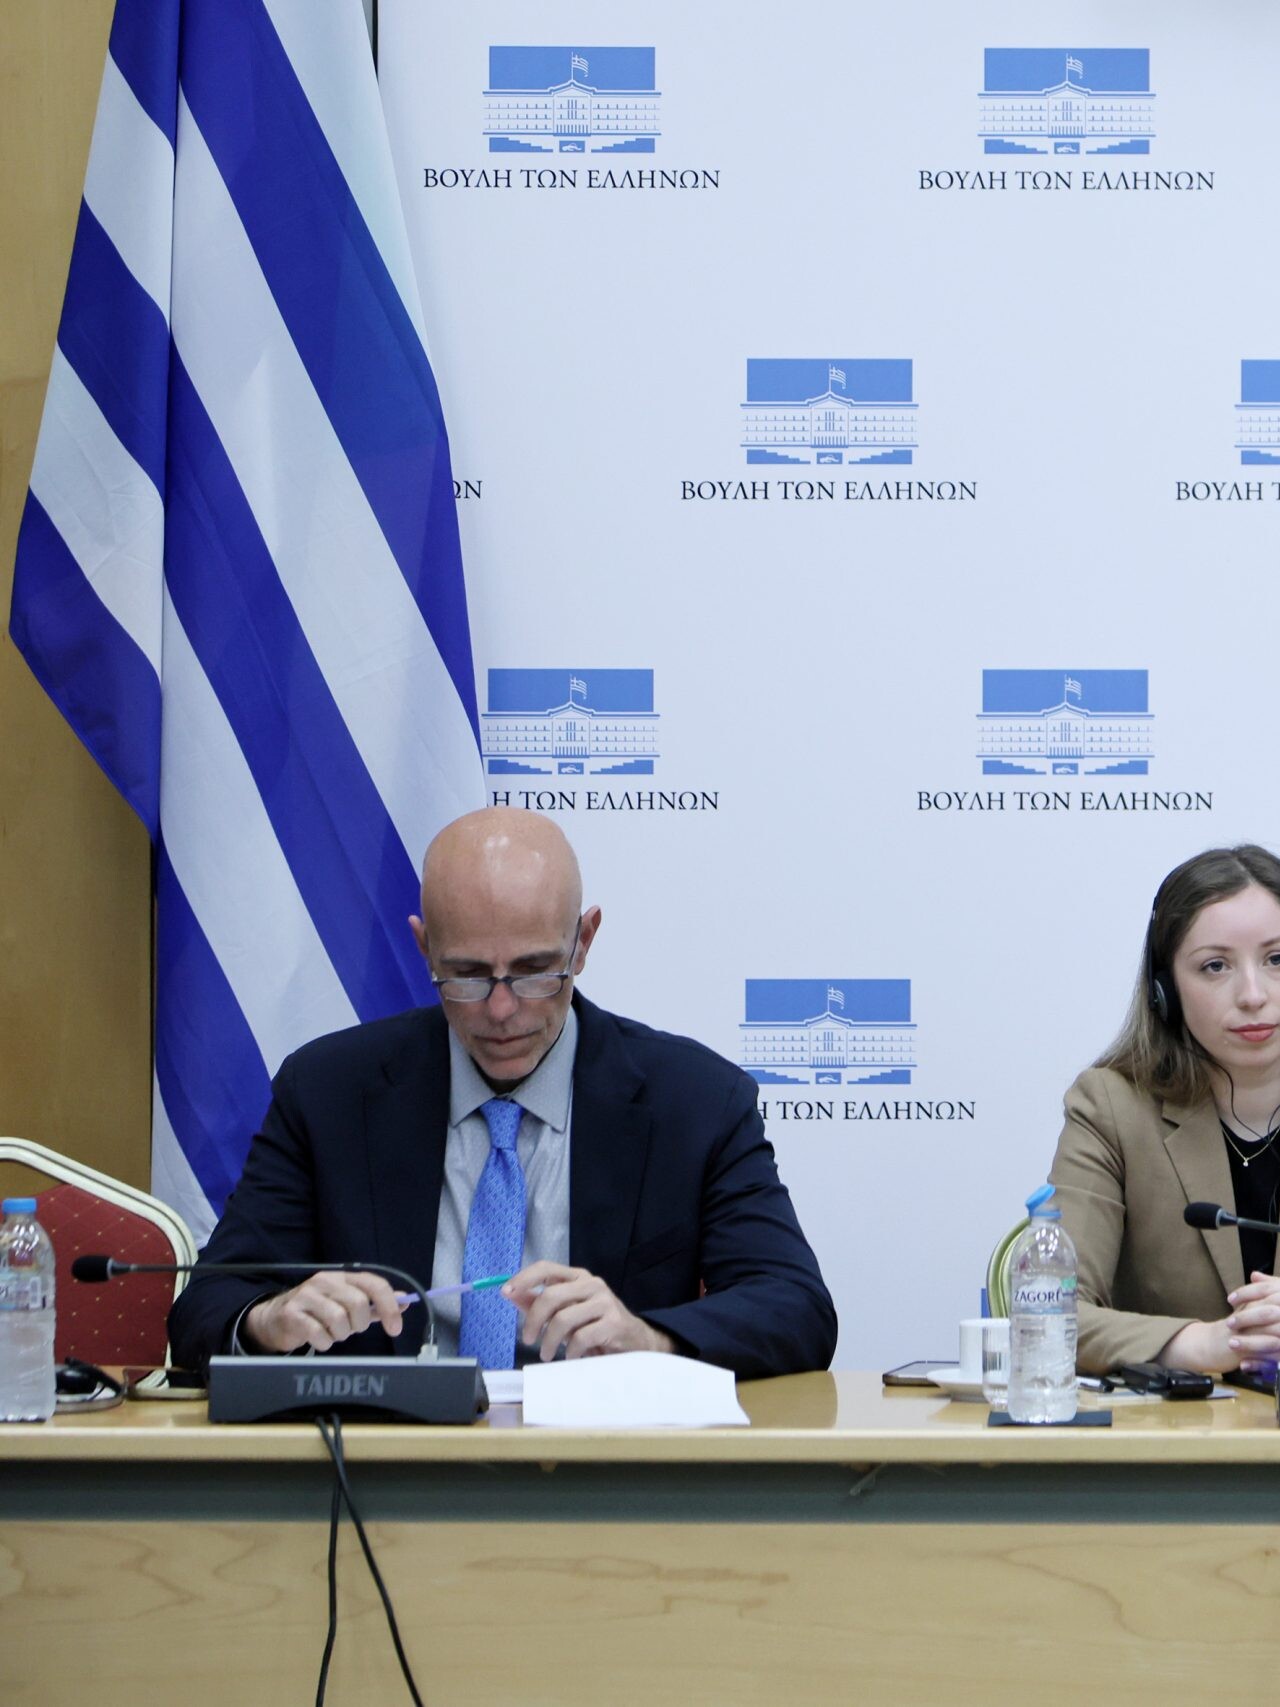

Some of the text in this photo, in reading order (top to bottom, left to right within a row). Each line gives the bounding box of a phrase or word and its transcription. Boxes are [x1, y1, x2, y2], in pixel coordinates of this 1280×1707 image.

[424, 168, 720, 189] ΒΟΥΛΗ ΤΩΝ ΕΛΛΗΝΩΝ
[919, 170, 1215, 190] ΒΟΥΛΗ ΤΩΝ ΕΛΛΗΝΩΝ
[681, 481, 976, 500] ΒΟΥΛΗ ΤΩΝ ΕΛΛΗΝΩΝ
[1176, 482, 1263, 500] ΒΟΥΛΗ
[518, 791, 576, 810] ΤΩΝ
[586, 792, 719, 810] ΕΛΛΗΝΩΝ
[917, 792, 1212, 810] ΒΟΥΛΗ ΤΩΝ ΕΛΛΗΝΩΝ
[776, 1101, 834, 1120] ΤΩΝ
[843, 1101, 976, 1120] ΕΛΛΗΝΩΝ
[294, 1374, 385, 1397] TAIDEN
